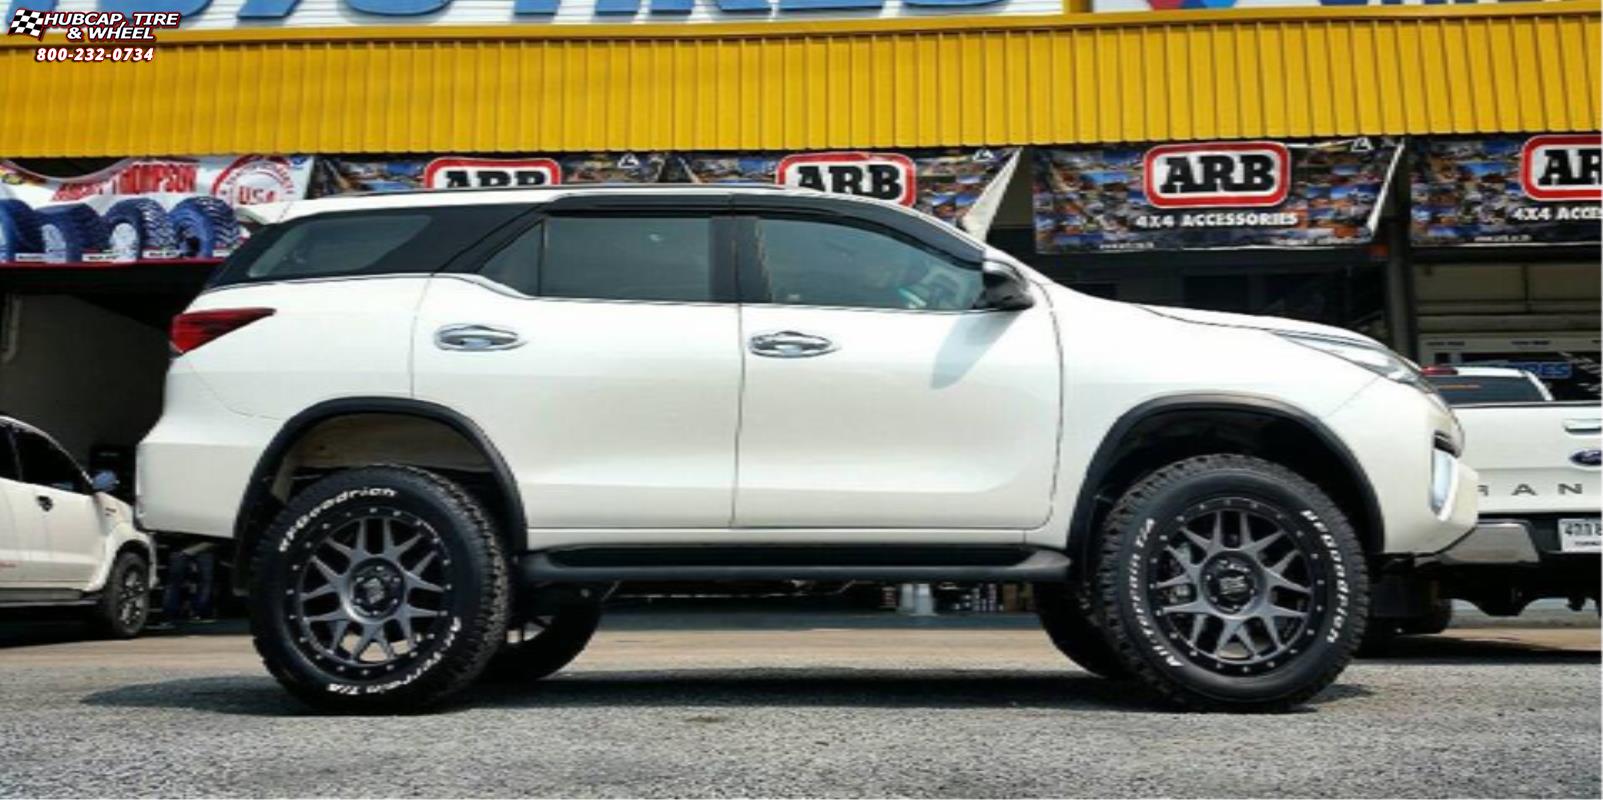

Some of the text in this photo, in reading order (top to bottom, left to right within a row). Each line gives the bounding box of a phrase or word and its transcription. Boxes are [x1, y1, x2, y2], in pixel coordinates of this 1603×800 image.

[797, 164, 902, 201] ARB
[1160, 154, 1275, 193] ARB
[1181, 212, 1299, 228] ACCESSORIES
